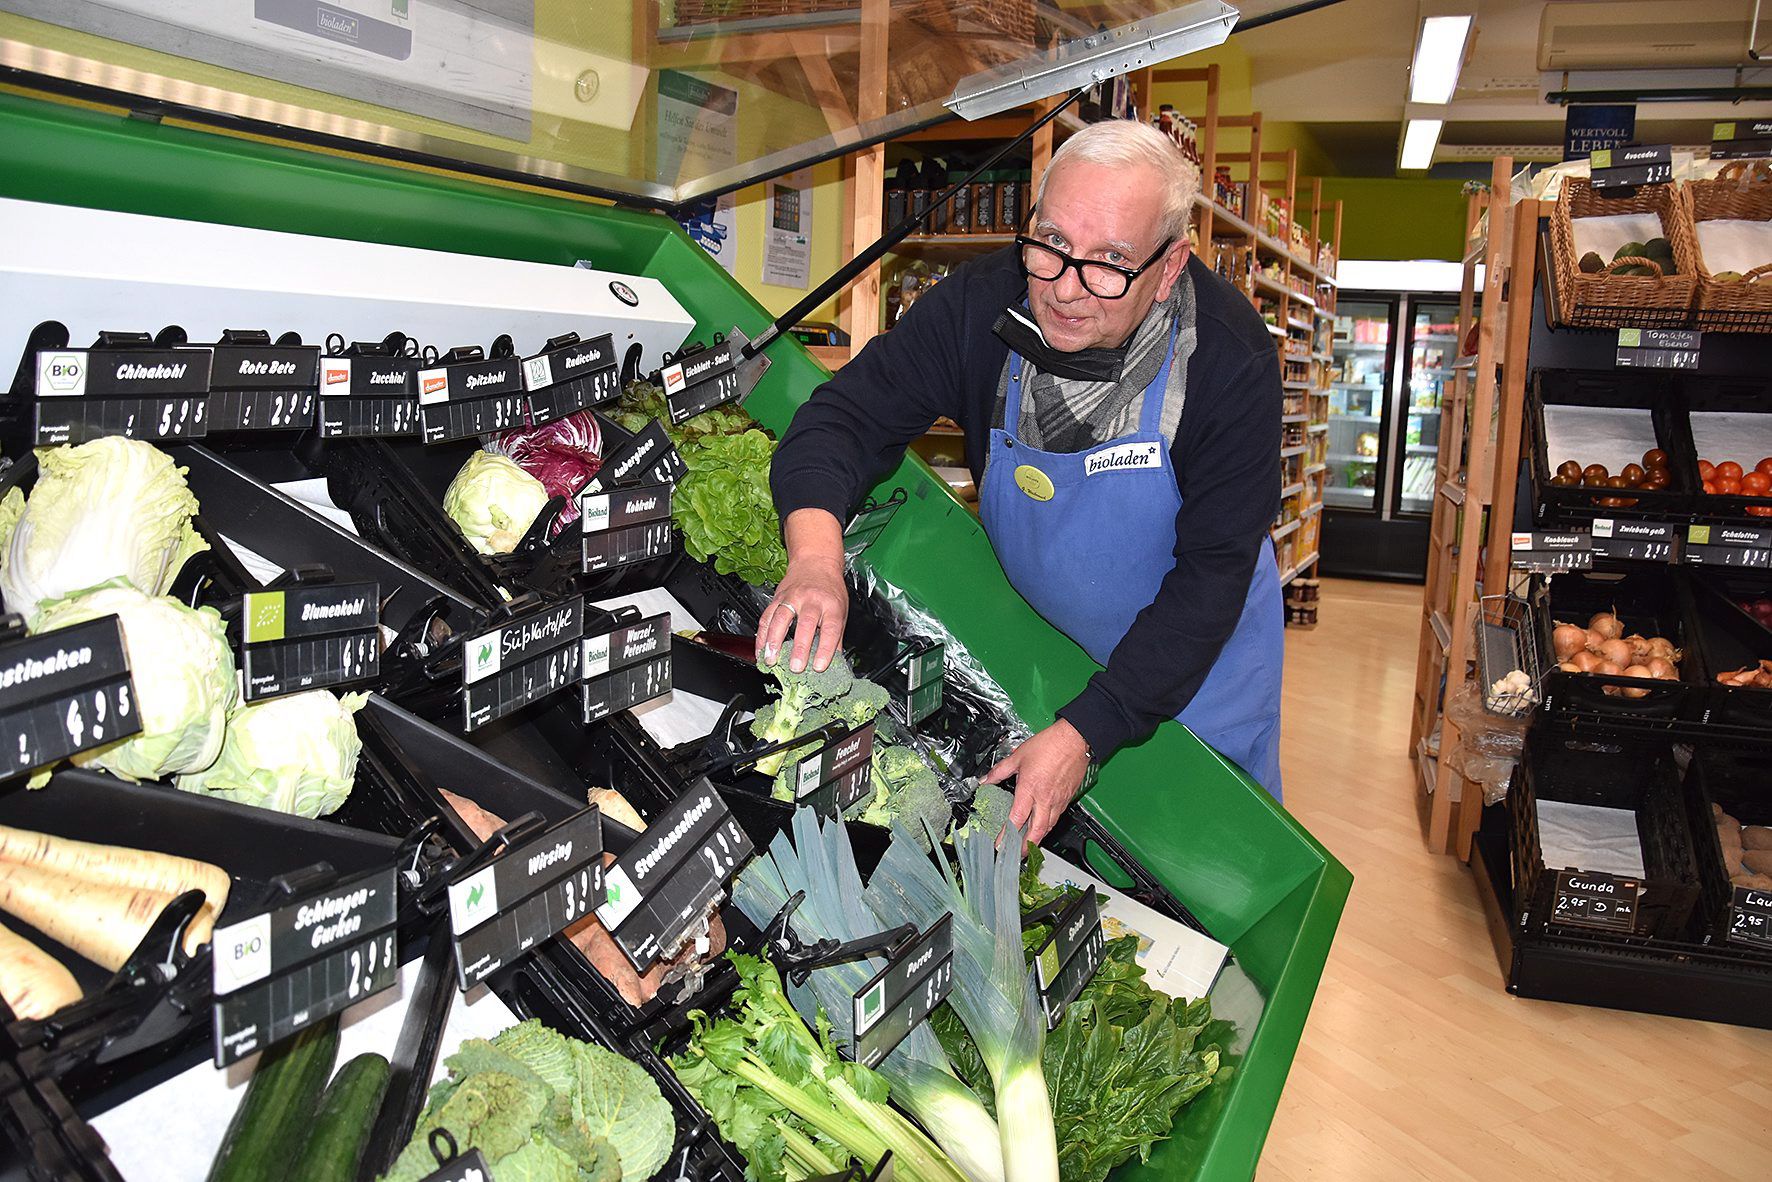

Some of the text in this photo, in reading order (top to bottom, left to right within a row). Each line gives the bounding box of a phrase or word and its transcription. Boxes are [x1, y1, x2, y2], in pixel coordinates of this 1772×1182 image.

[320, 13, 352, 33] bioladen
[1571, 128, 1628, 137] WERTVOLL
[1625, 151, 1658, 159] Avocados
[1647, 330, 1693, 340] Tomaten
[239, 359, 296, 375] Rote Bete
[566, 349, 601, 369] Radicchio
[116, 363, 187, 380] Chinakohl
[370, 371, 407, 385] Zucchini
[466, 370, 506, 390] Spitzkohl
[614, 438, 655, 478] Auberginen
[1088, 450, 1149, 473] bioladen
[588, 507, 608, 518] Bioland
[626, 497, 656, 514] Kohlrabi
[1721, 530, 1759, 539] Schalotten
[301, 598, 365, 621] Blumenkohl
[627, 623, 655, 643] Wurzel-
[588, 647, 608, 662] Bioland
[623, 637, 657, 659] Petersilie
[0, 646, 92, 690] stinaken
[835, 737, 861, 761] Fenchel
[634, 796, 712, 880] Staudensellerie
[528, 840, 573, 876] Wirsing
[1568, 877, 1614, 894] Gunda
[295, 888, 376, 931] Schlangen-
[311, 914, 362, 949] Gurken
[906, 947, 933, 978] Porree
